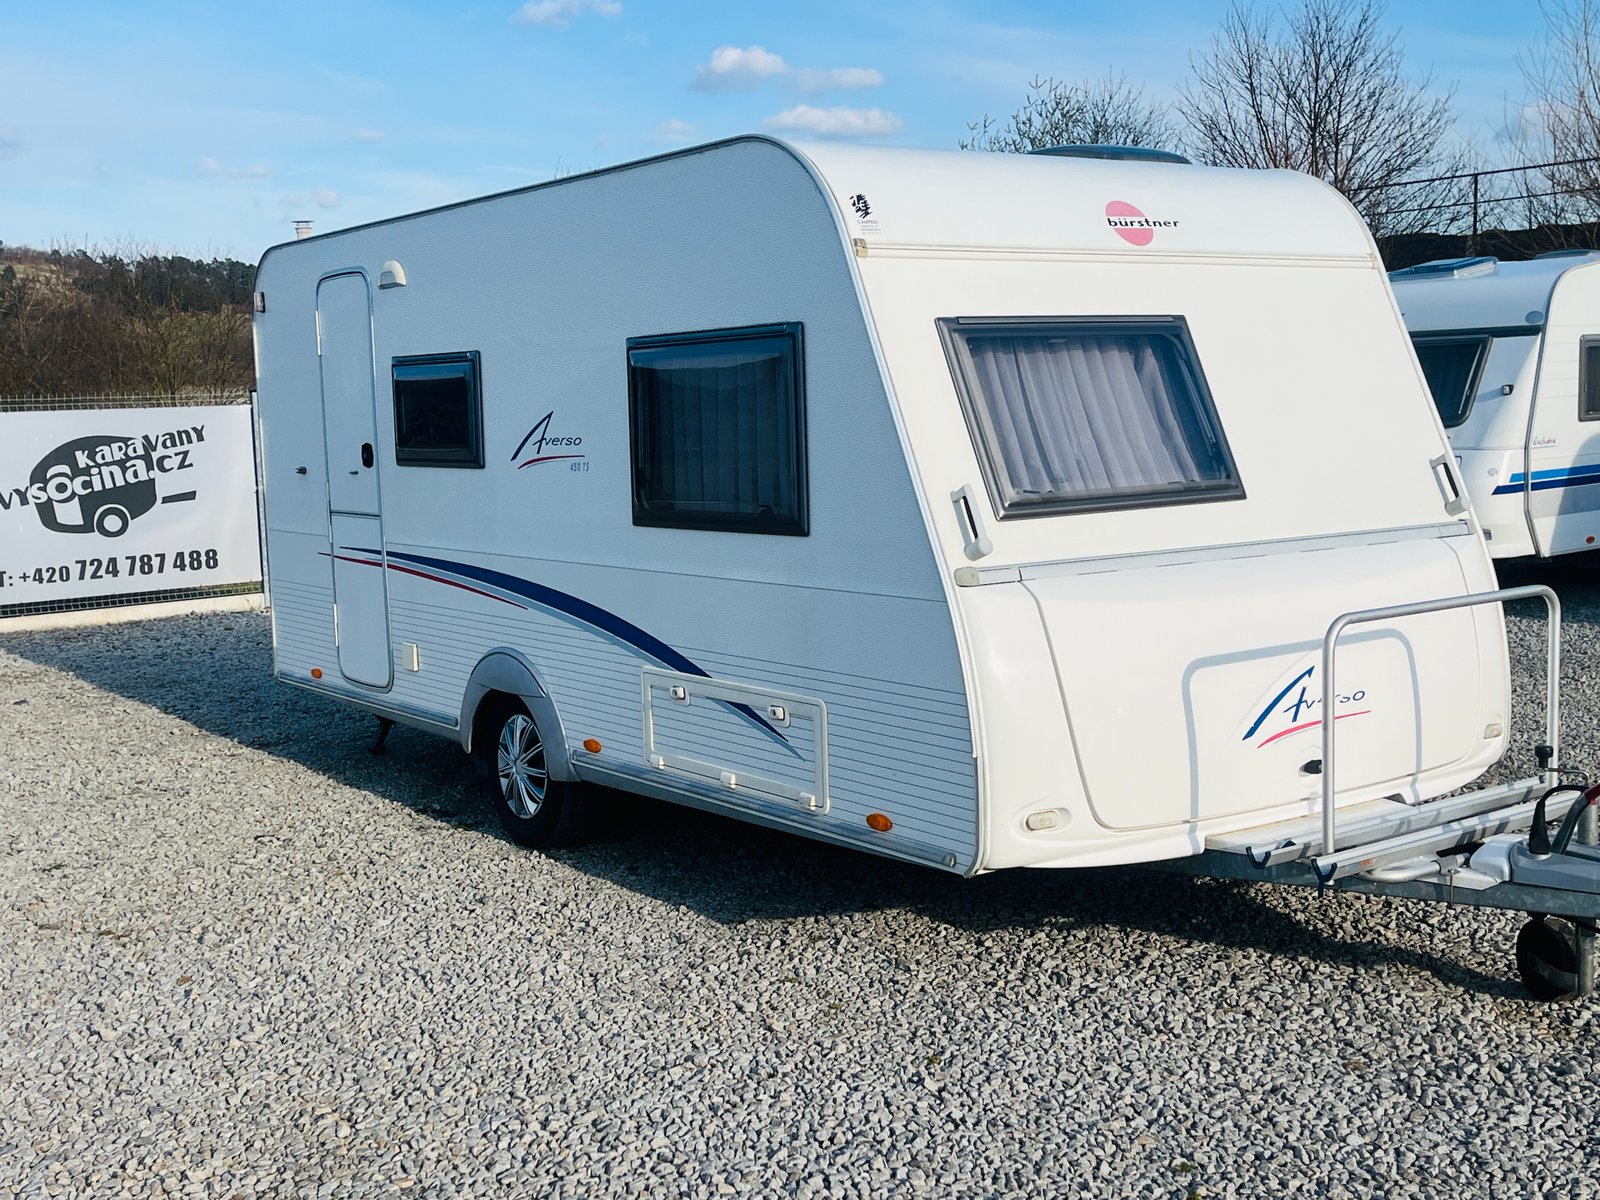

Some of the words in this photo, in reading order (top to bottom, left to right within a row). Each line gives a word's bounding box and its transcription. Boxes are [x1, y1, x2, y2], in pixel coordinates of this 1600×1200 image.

[1106, 217, 1180, 228] bürstner
[510, 410, 583, 462] Averso
[19, 565, 71, 585] +420
[75, 556, 120, 581] 724
[125, 553, 166, 577] 787
[172, 548, 219, 572] 488
